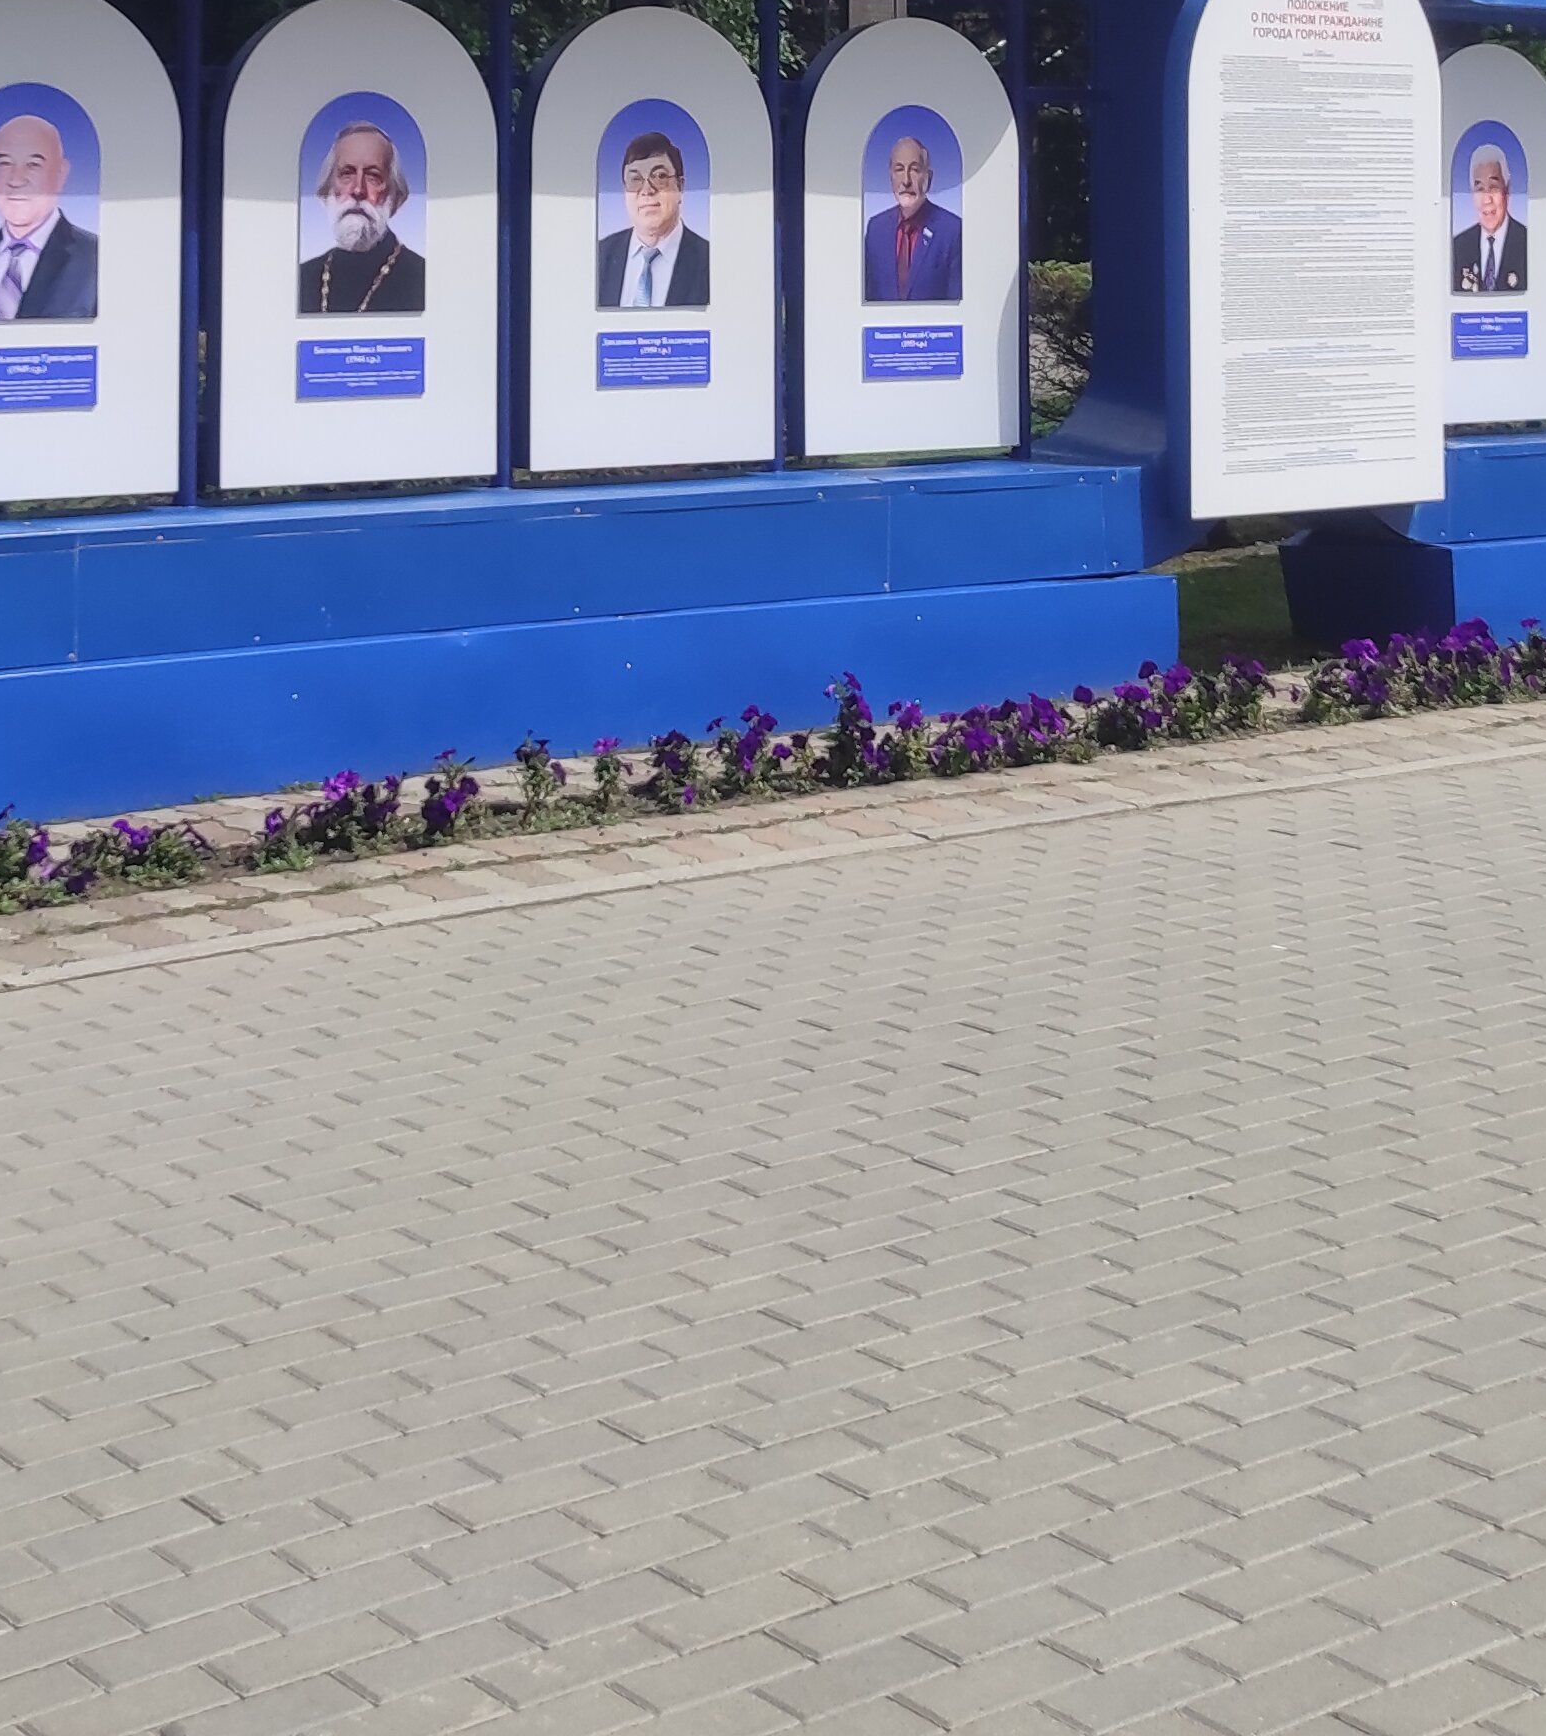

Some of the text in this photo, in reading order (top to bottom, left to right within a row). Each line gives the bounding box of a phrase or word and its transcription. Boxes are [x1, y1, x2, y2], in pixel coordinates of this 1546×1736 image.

[1250, 12, 1383, 28] О ПОЧЕТНОМ ГРАЖДАНИНЕ
[1253, 27, 1382, 42] ГОРОДА ГОРНО-АЛТАЙСКА
